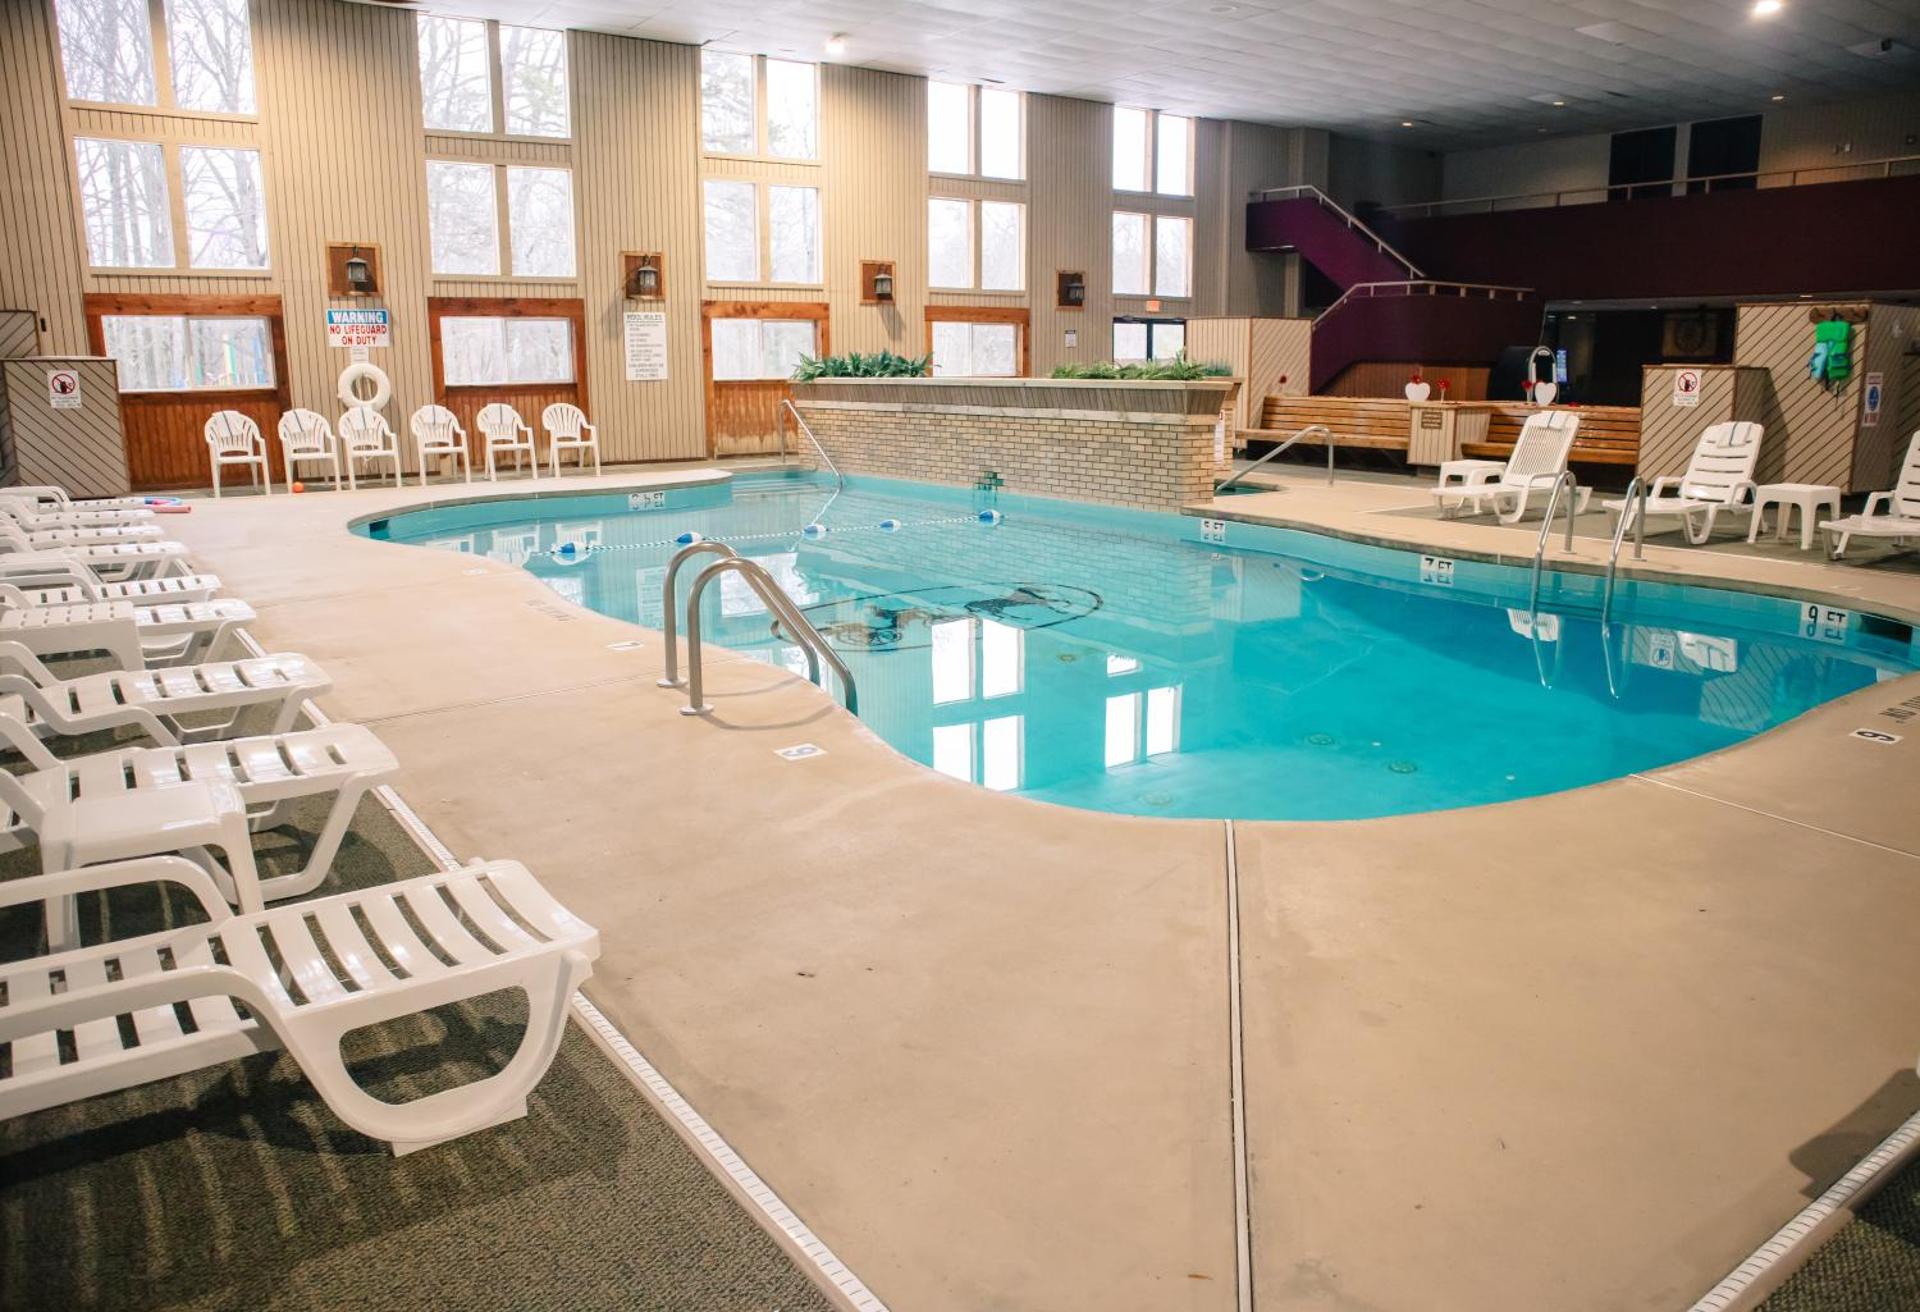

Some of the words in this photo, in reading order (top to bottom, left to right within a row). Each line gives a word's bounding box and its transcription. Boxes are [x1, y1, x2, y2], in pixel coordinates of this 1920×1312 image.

[331, 311, 384, 323] WARNING
[329, 325, 341, 334] NO
[344, 325, 387, 334] LIFEGUARD
[342, 336, 352, 345] ON
[356, 336, 376, 345] DUTY
[1438, 560, 1452, 570] FT
[1827, 611, 1846, 623] FT
